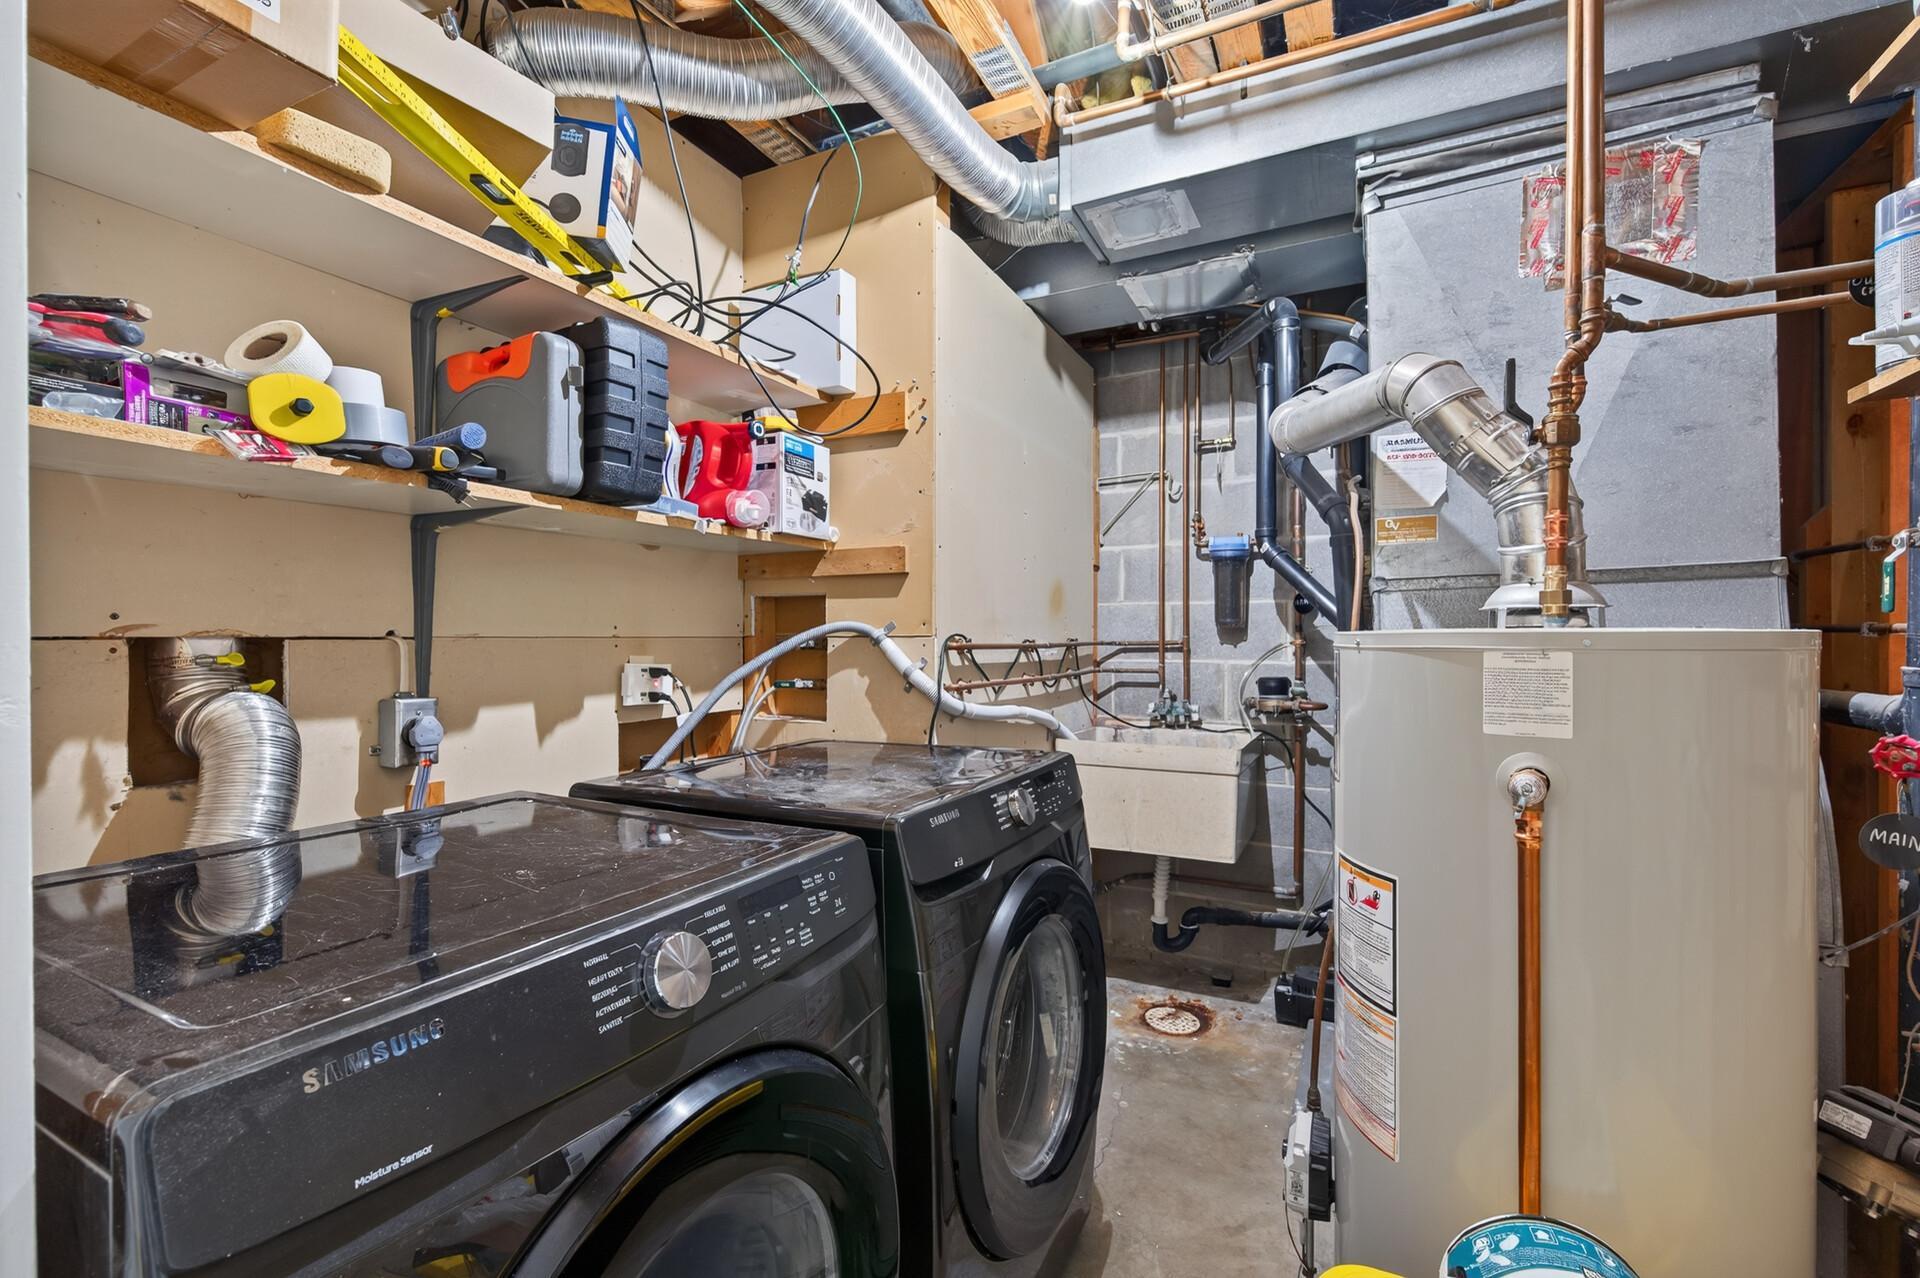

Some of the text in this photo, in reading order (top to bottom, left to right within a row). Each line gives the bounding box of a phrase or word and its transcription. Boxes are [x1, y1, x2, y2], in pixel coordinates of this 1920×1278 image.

[1869, 827, 1920, 852] MAIN
[302, 1017, 446, 1094] SAMSUNG
[354, 1143, 434, 1190] Moisture Sensor
